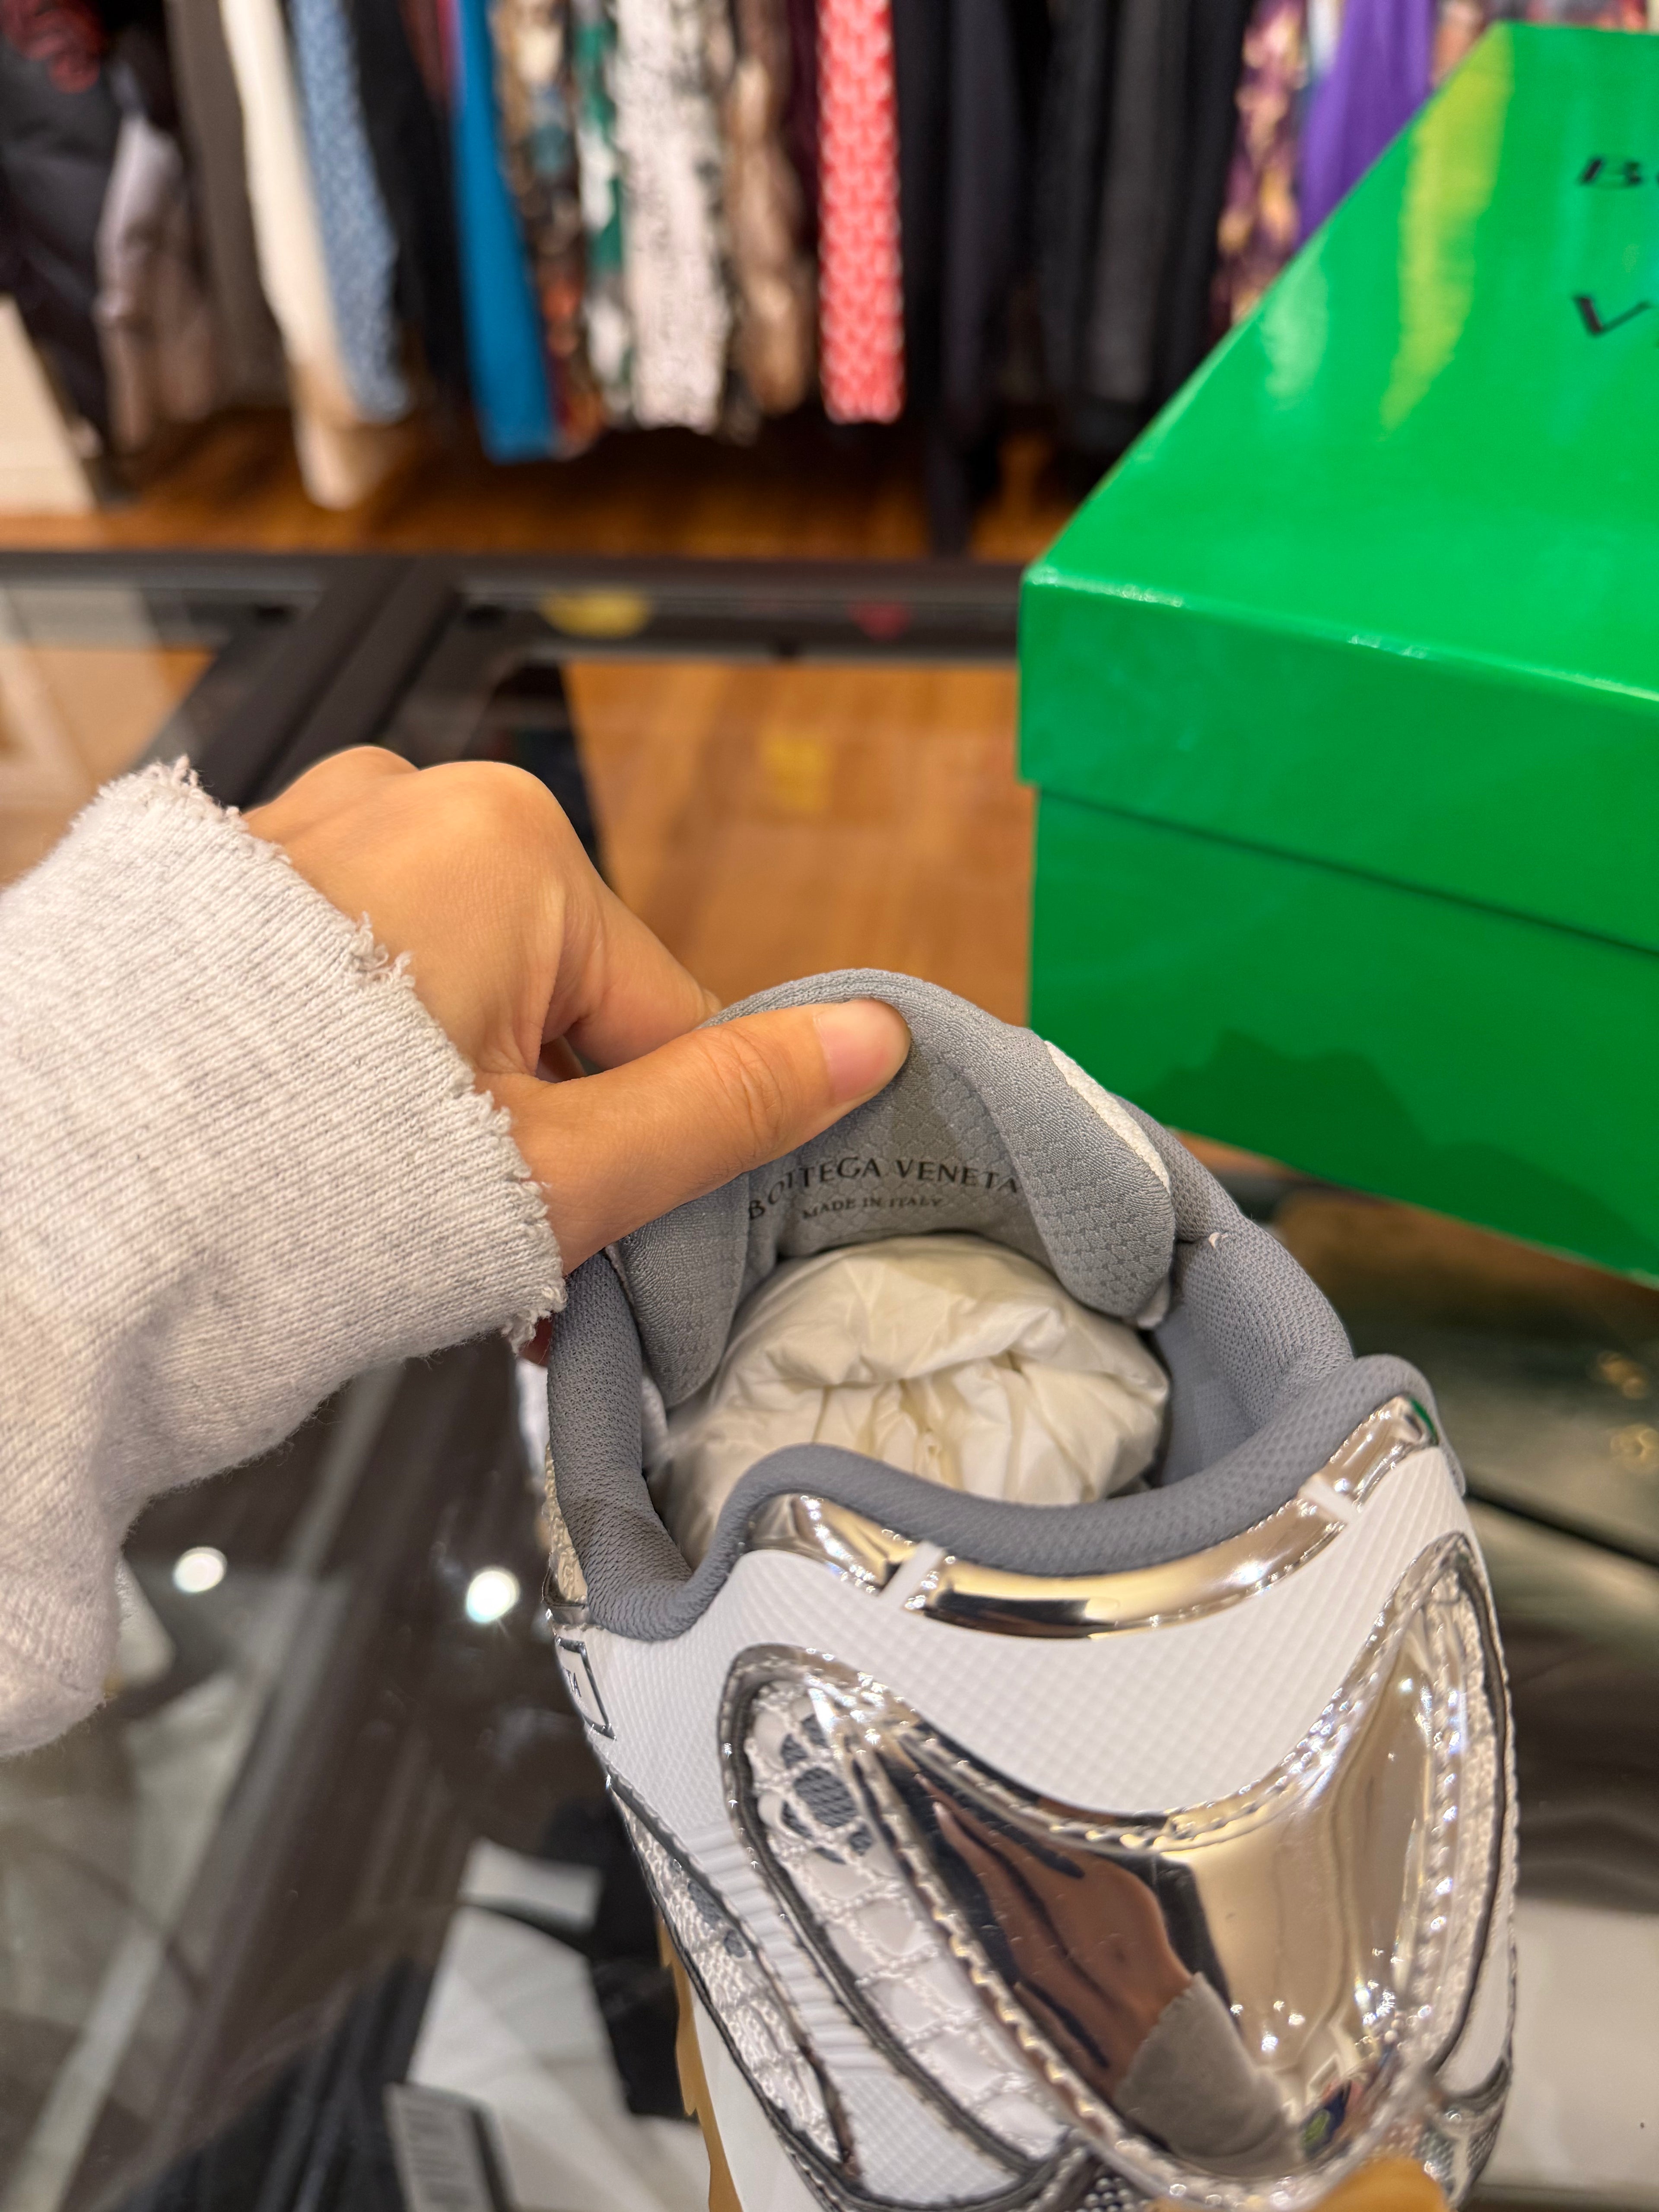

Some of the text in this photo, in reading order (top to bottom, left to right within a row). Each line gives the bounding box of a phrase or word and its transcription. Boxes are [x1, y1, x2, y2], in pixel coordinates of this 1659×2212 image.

[1577, 155, 1659, 189] B
[748, 1156, 1017, 1220] BOTTEGA VENETA
[802, 1196, 943, 1218] MADE IN ITALY
